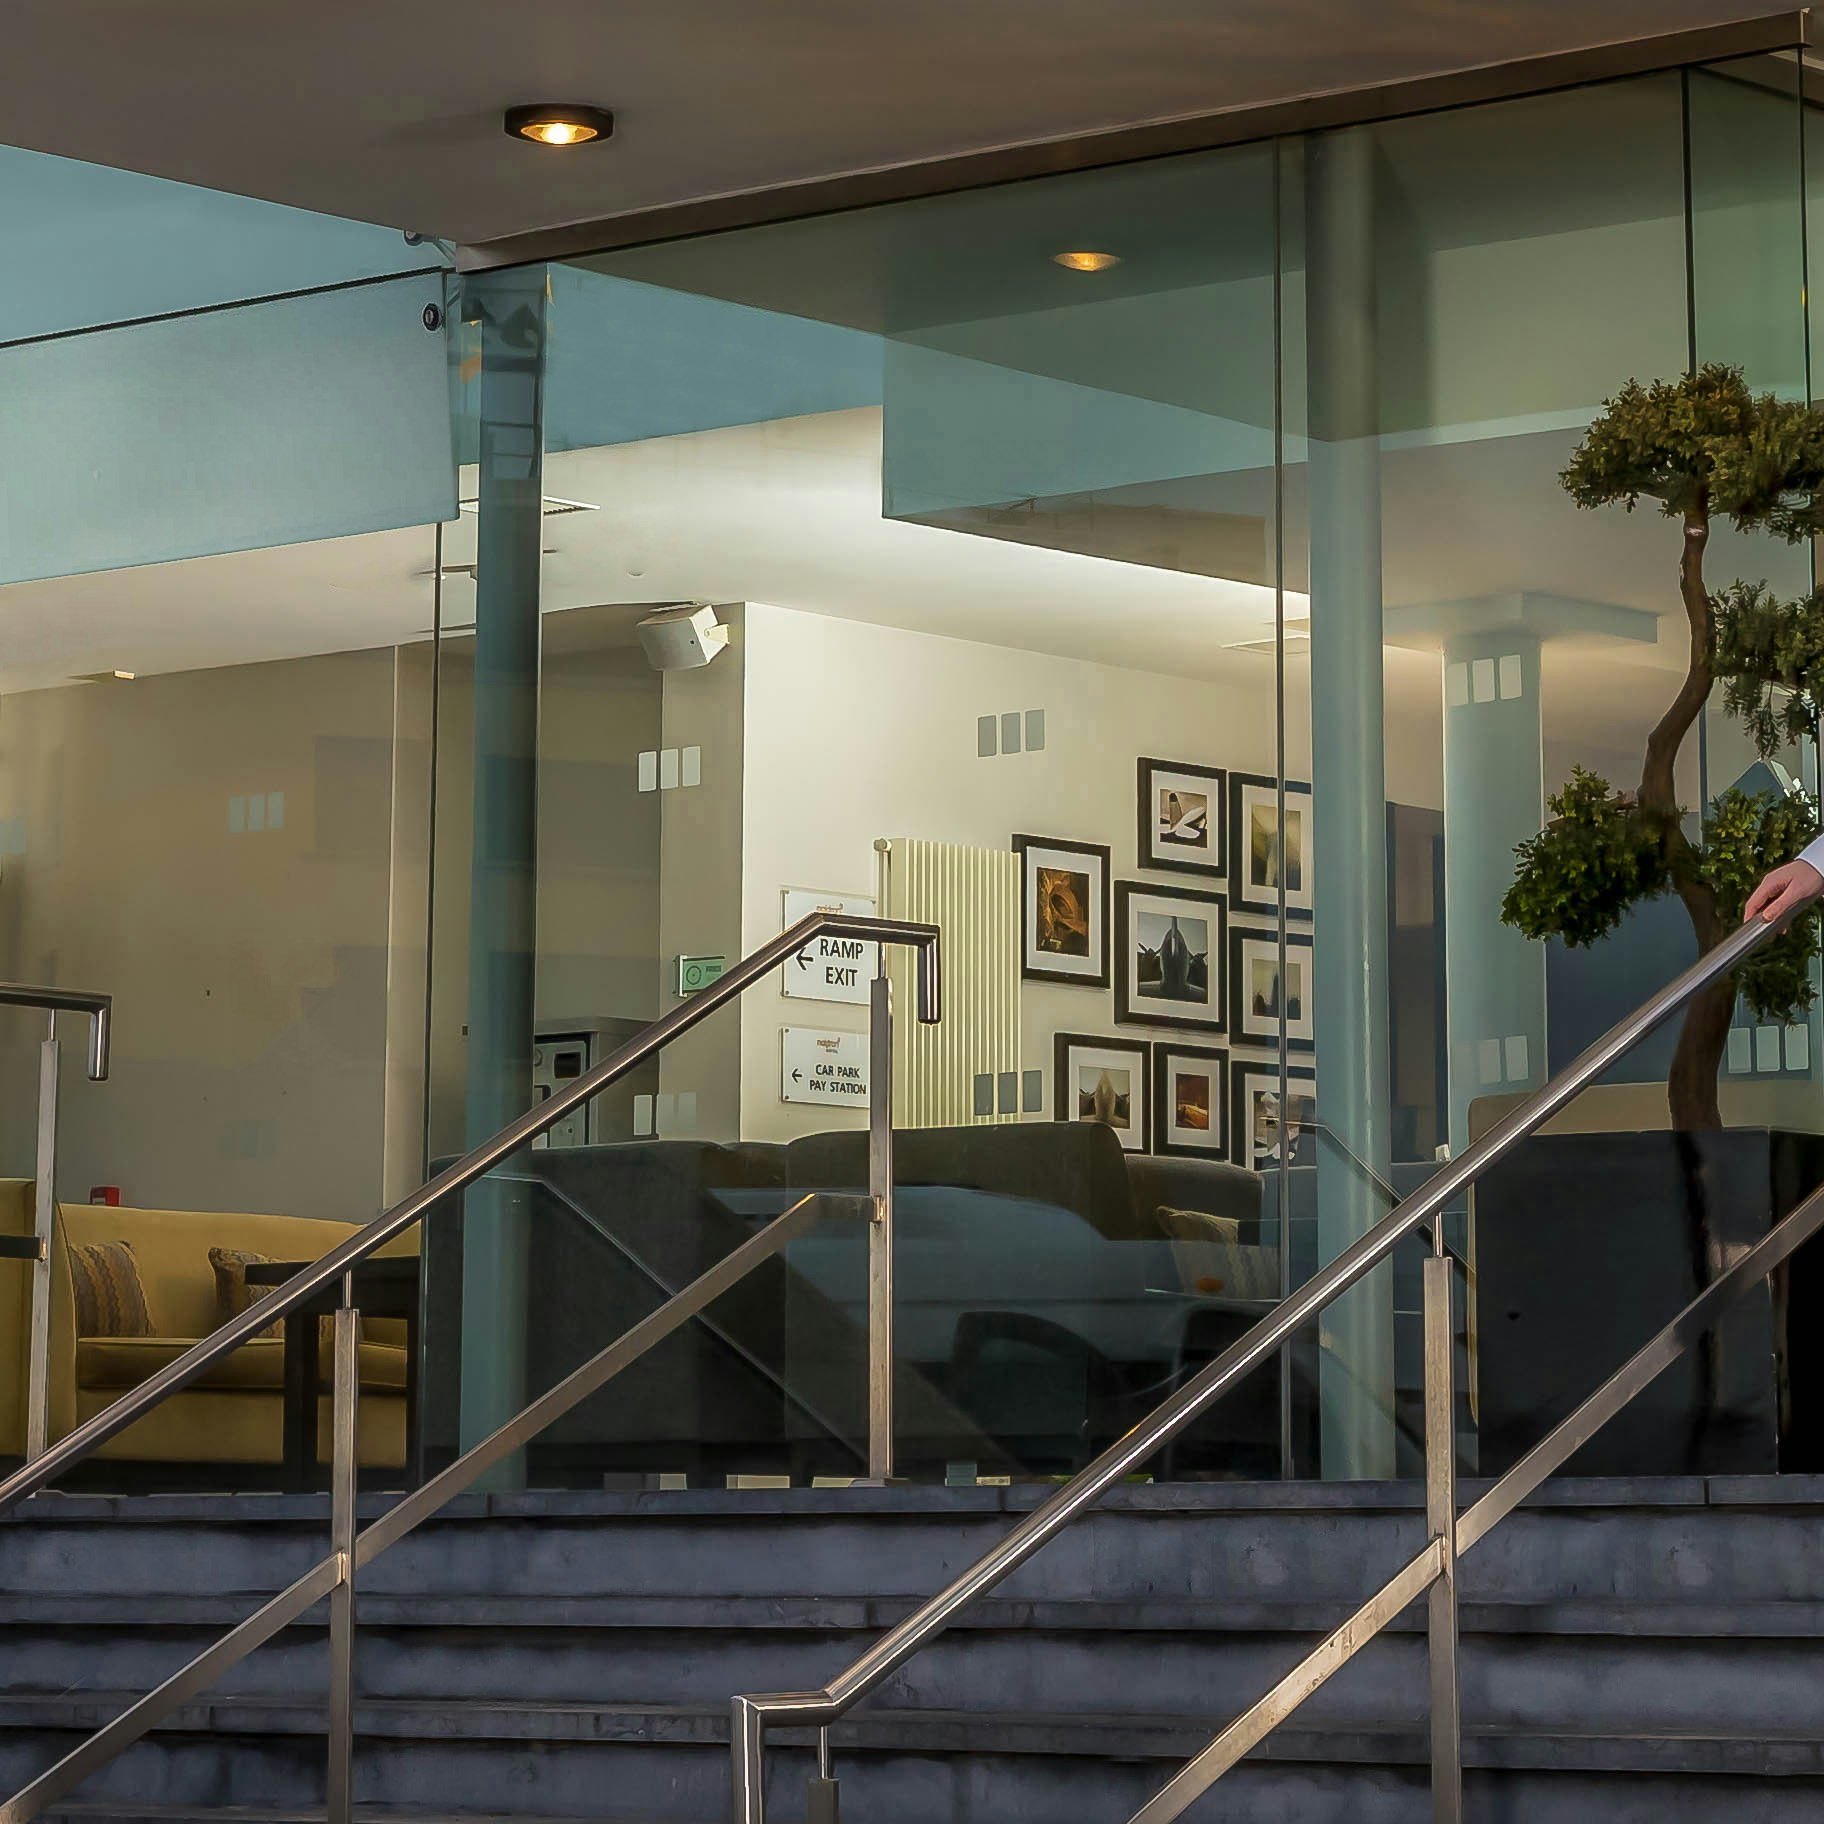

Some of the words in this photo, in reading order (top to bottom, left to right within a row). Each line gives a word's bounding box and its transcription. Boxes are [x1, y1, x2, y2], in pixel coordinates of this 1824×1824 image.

[819, 938, 864, 960] RAMP
[825, 966, 858, 987] EXIT
[815, 1064, 834, 1077] CAR
[837, 1066, 860, 1079] PARK
[809, 1079, 827, 1092] PAY
[829, 1081, 867, 1095] STATION
